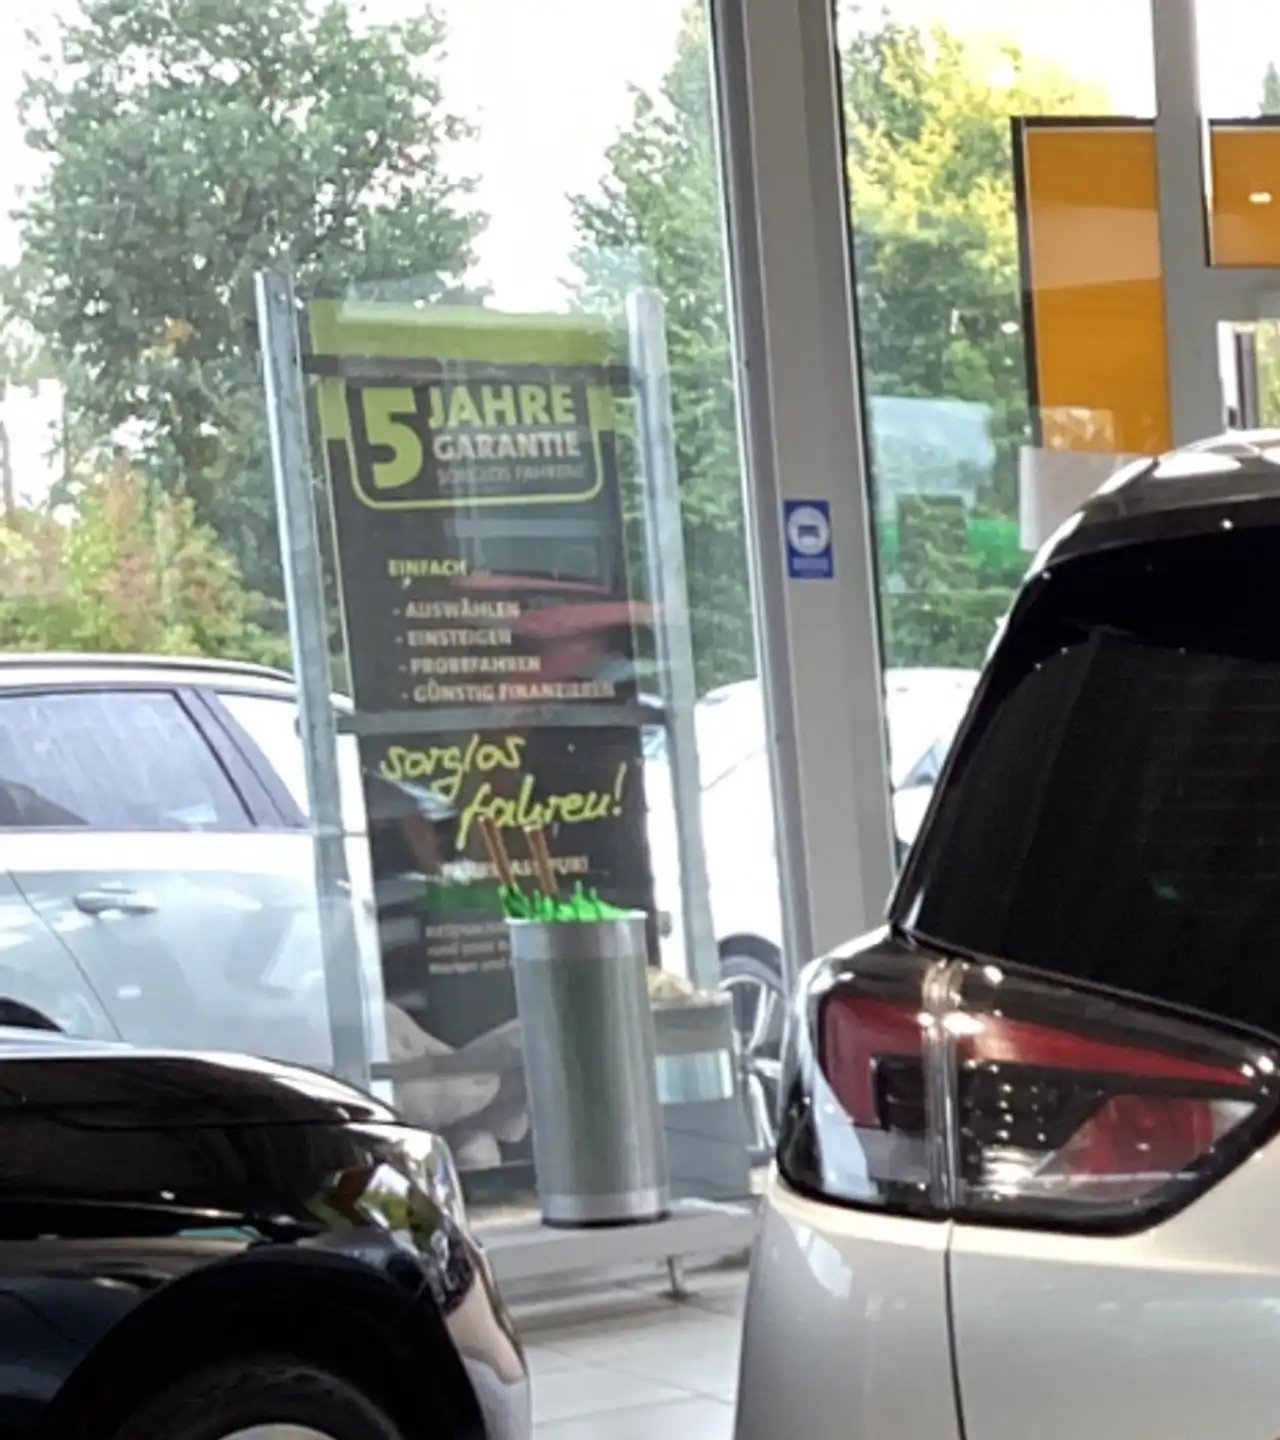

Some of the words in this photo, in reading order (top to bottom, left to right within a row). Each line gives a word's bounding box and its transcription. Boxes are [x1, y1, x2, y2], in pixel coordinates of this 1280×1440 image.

[428, 384, 577, 429] JAHRE
[362, 386, 424, 489] 5
[432, 430, 581, 461] GARANTIE
